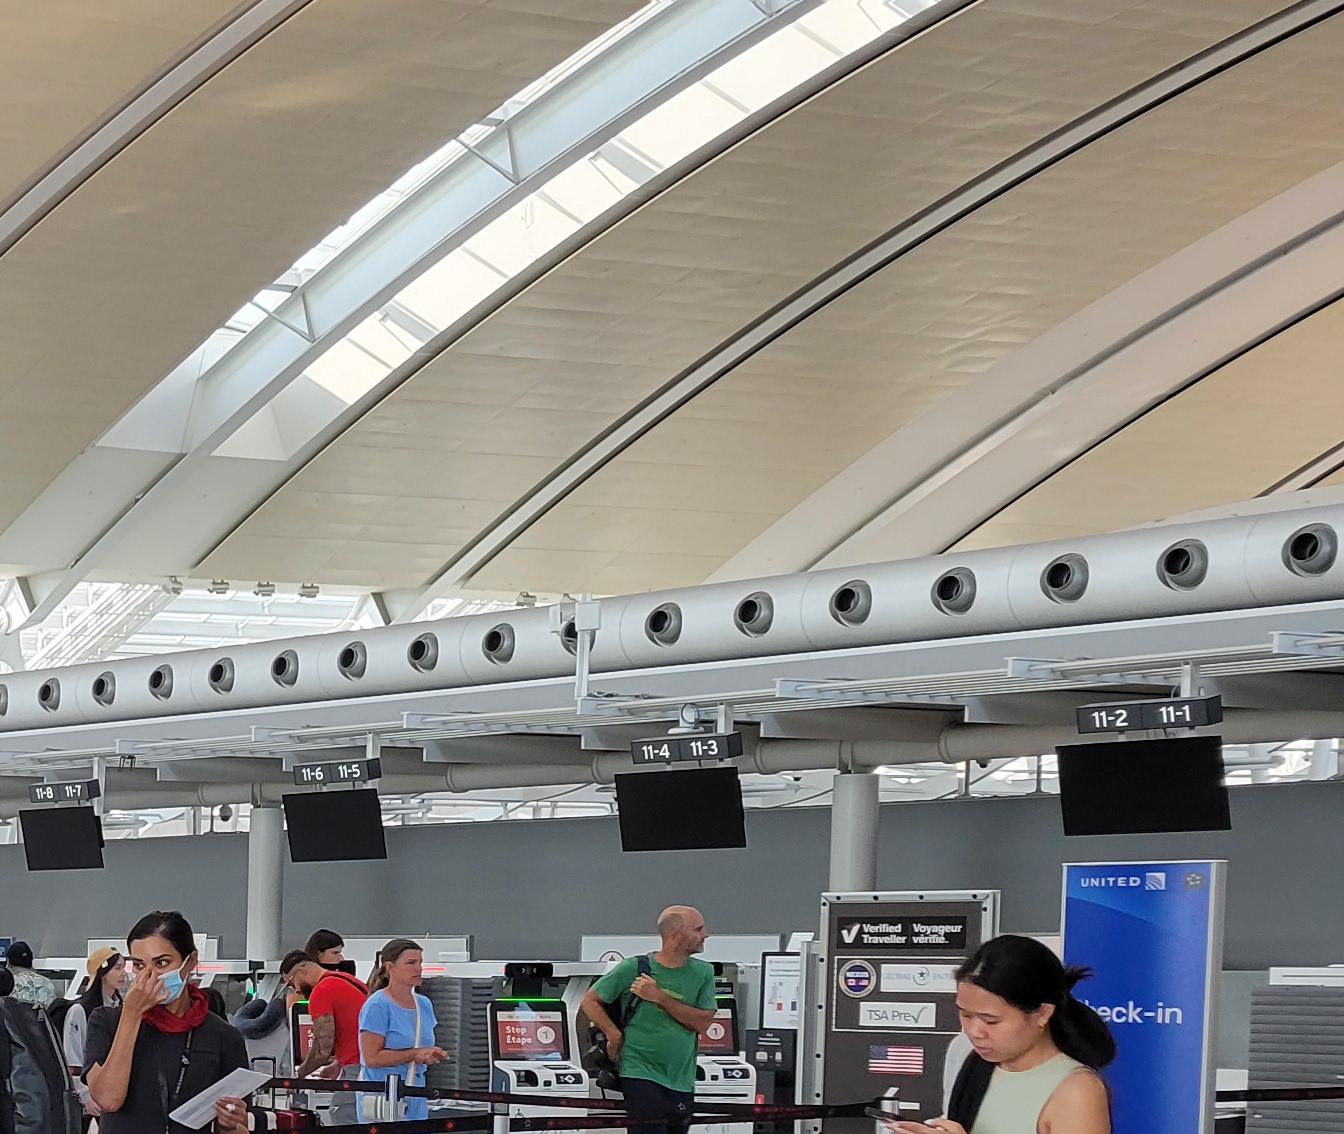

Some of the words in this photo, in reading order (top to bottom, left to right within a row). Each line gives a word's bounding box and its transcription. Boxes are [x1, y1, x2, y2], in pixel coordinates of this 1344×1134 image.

[1092, 710, 1128, 728] 11-2
[1159, 705, 1190, 724] 11-1
[642, 744, 670, 760] 11-4
[690, 740, 718, 756] 11-3
[302, 767, 323, 781] 11-6
[338, 764, 360, 778] 11-5
[36, 787, 53, 800] 11-8
[65, 785, 81, 798] 11-7
[1080, 877, 1141, 888] UNITED
[863, 923, 902, 933] Verified
[912, 923, 963, 935] Voyageur
[862, 935, 907, 944] Traveller
[867, 1010, 889, 1021] TSA
[506, 1025, 527, 1036] Step
[506, 1035, 532, 1045] Étape
